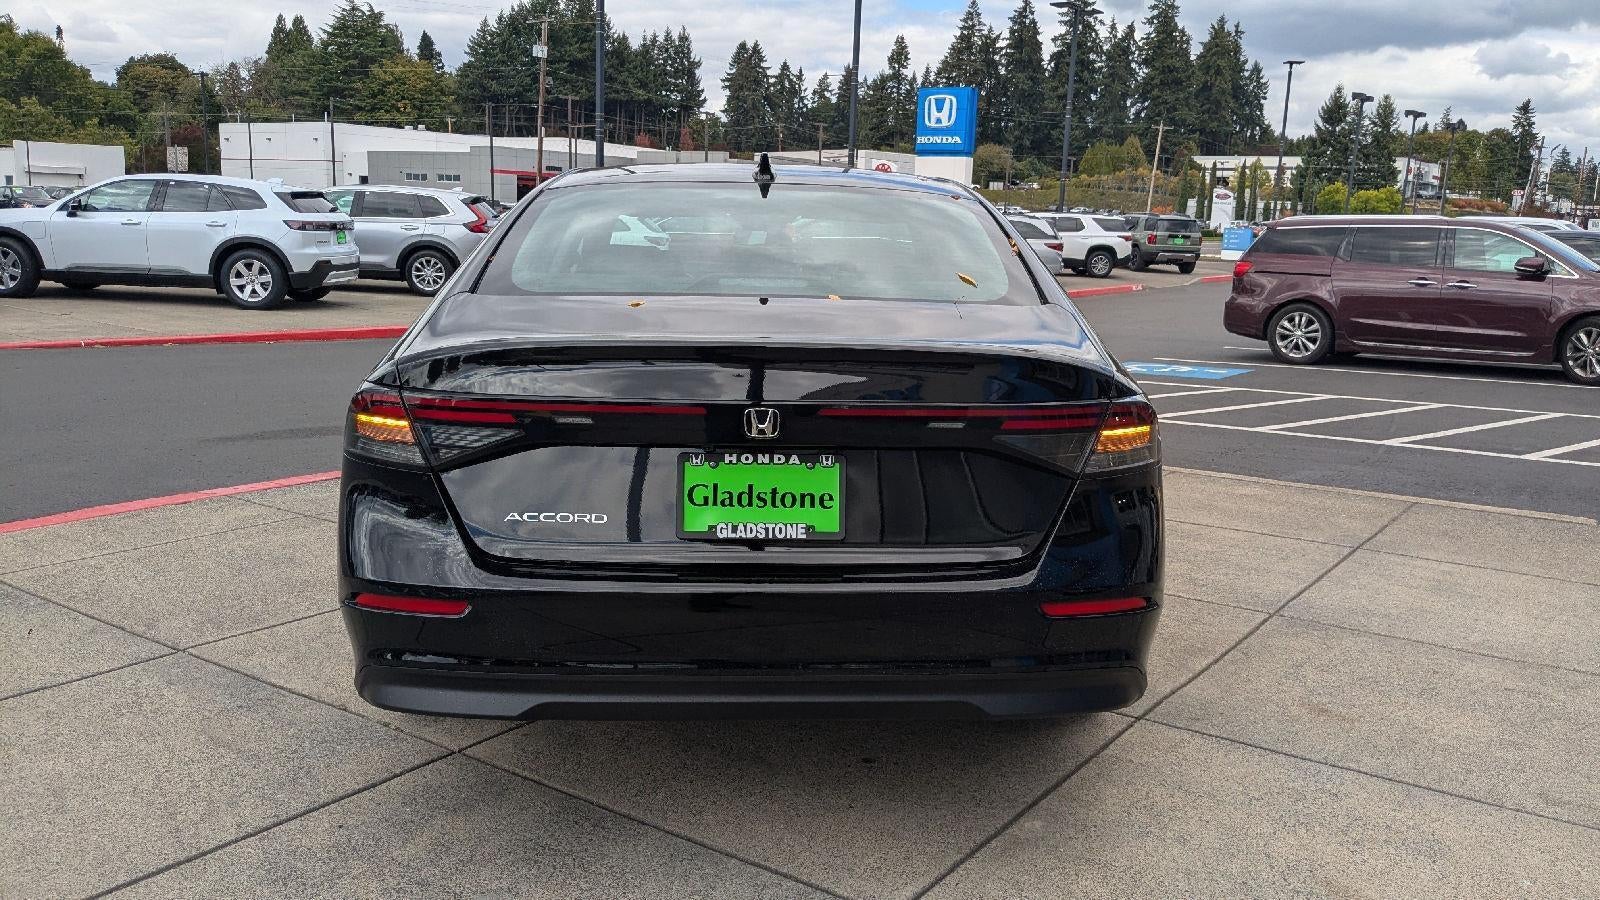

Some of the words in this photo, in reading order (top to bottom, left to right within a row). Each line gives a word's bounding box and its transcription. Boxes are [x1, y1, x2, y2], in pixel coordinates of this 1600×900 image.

[916, 136, 962, 144] HONDA
[724, 453, 801, 465] HONDA
[686, 482, 835, 510] Gladstone
[503, 512, 608, 524] ACCORD
[716, 522, 807, 539] GLADSTONE
